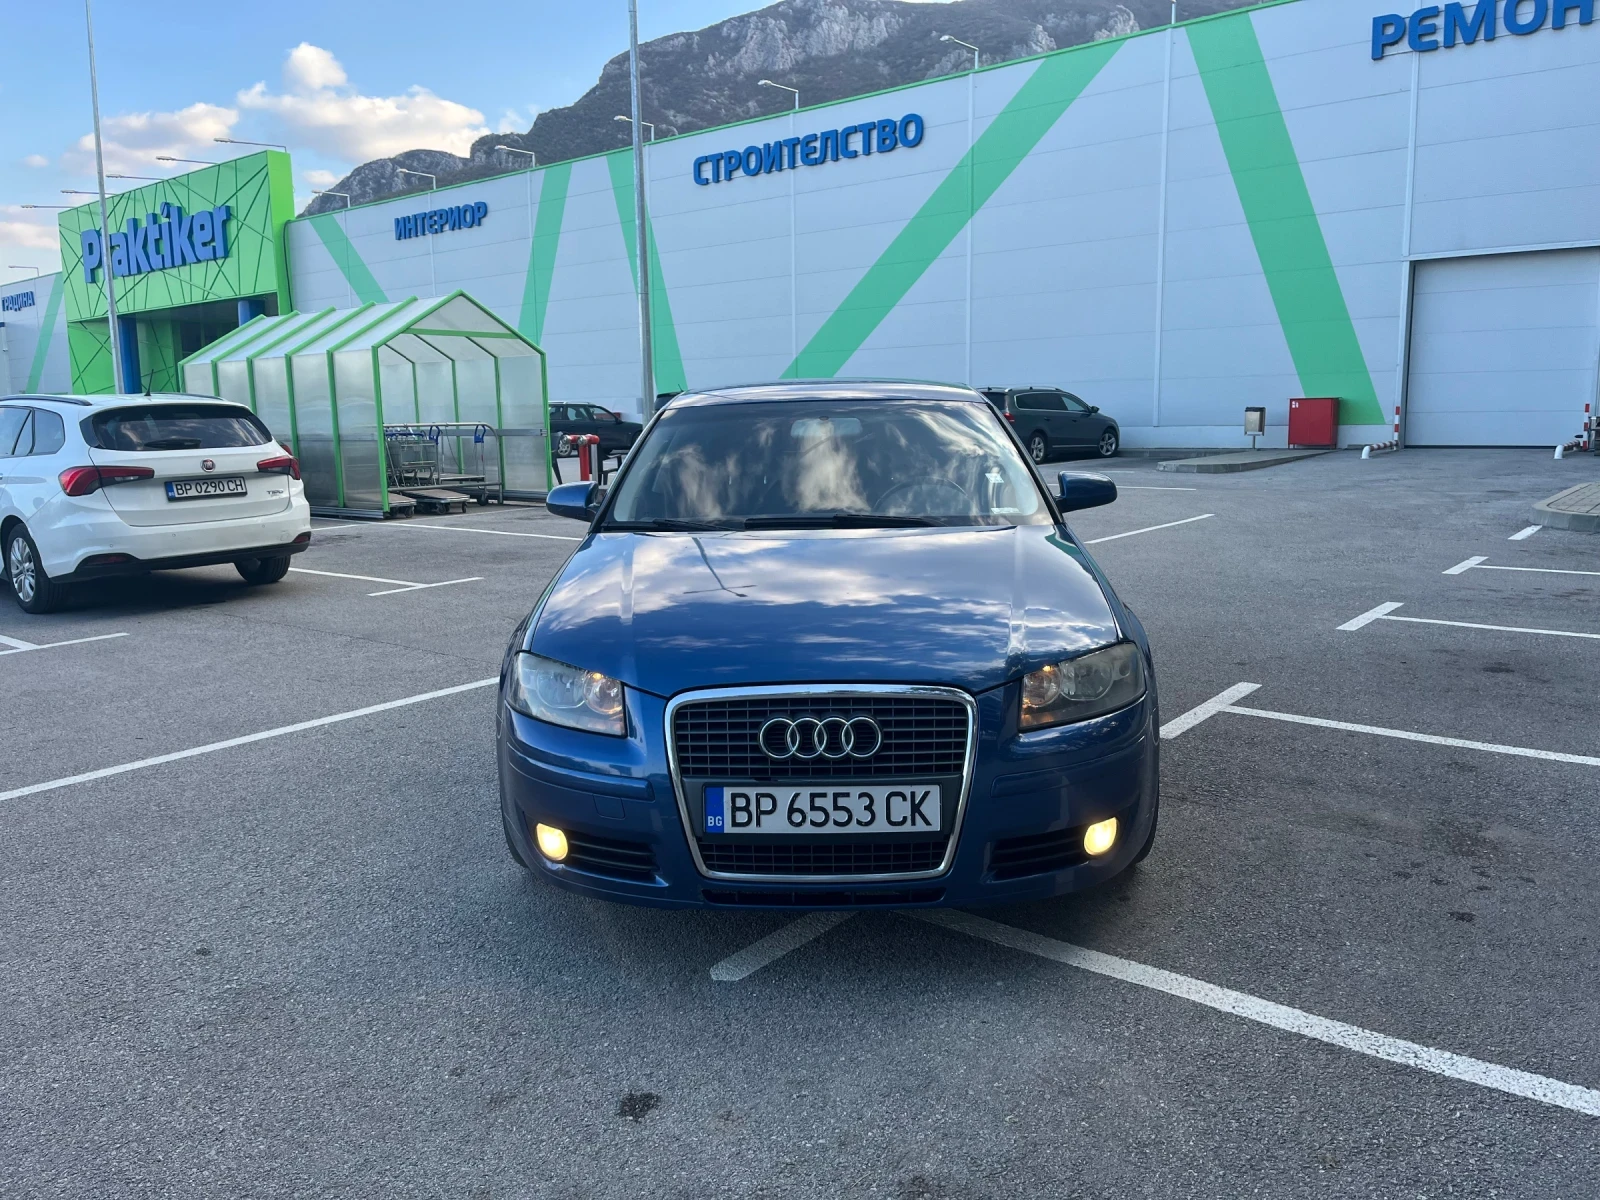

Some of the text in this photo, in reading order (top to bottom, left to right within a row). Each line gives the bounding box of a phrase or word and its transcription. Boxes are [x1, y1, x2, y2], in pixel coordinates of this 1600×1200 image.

[693, 113, 924, 185] СТРОИТЕЛСТВО
[394, 201, 488, 241] ИНТЕРИОР
[81, 202, 231, 284] Paktiker
[1, 291, 36, 312] ГРАДИНА
[175, 480, 244, 496] BP 0290 CH
[707, 815, 723, 827] BG
[730, 790, 932, 828] BP 6553 CK
